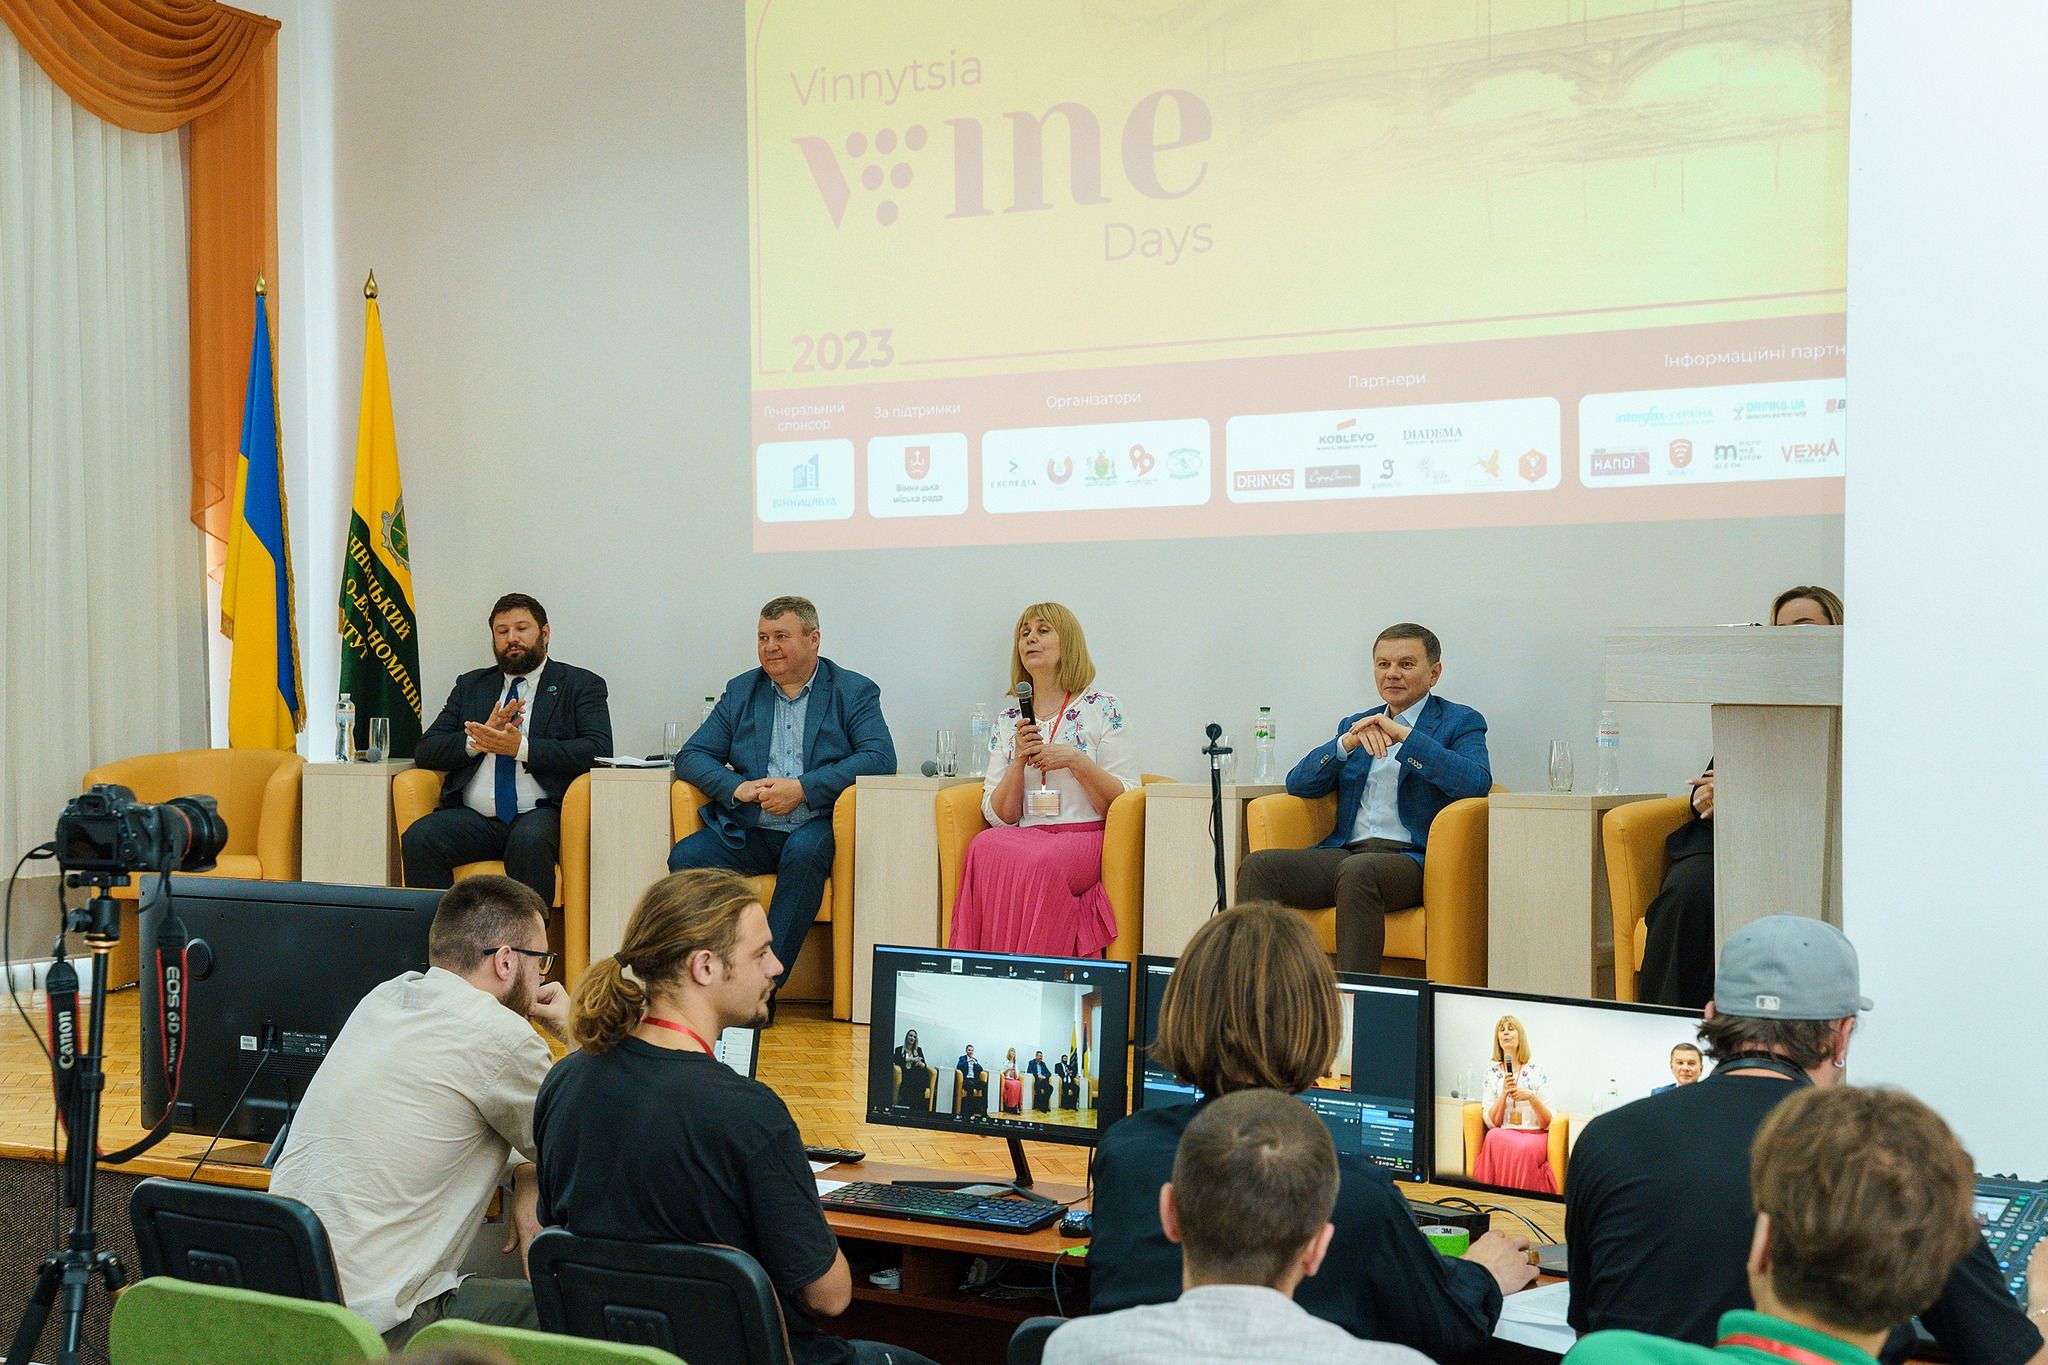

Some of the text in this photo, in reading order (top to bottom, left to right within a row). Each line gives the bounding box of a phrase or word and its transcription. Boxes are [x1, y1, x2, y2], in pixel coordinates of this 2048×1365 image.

[790, 50, 982, 107] Vinnytsia
[1104, 223, 1213, 265] Days
[791, 328, 895, 373] 2023
[1664, 347, 1785, 369] Інформаційні
[1348, 374, 1426, 391] Партнери
[763, 401, 846, 418] Генеральний
[1046, 392, 1142, 410] Організатори
[873, 403, 961, 420] За підтримки
[777, 420, 832, 432] спонсор
[1402, 426, 1464, 442] DIADEMA
[1319, 433, 1375, 445] KOBLEVO
[1236, 473, 1292, 488] DRINKS
[166, 966, 180, 1008] EOS
[167, 1011, 180, 1034] 6D
[58, 1011, 75, 1070] Canon
